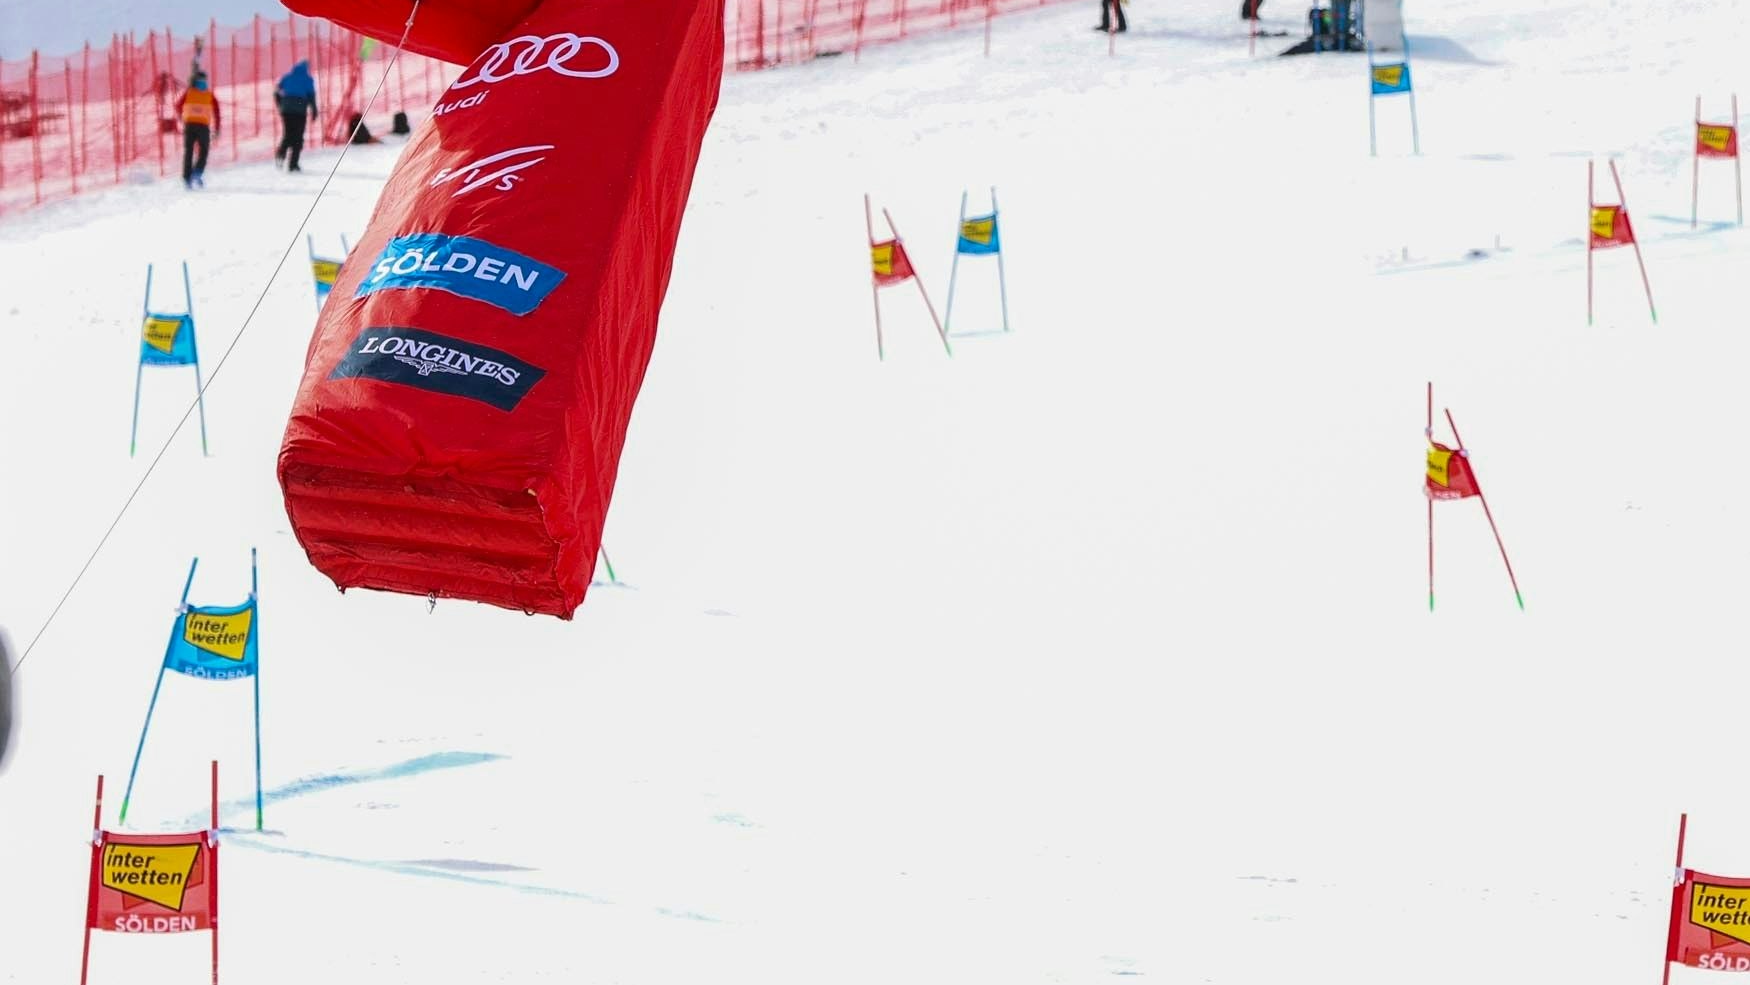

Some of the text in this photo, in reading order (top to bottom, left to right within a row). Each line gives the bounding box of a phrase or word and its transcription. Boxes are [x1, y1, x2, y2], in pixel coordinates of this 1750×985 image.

[433, 90, 490, 116] Audi
[371, 248, 540, 292] SÖLDEN
[359, 337, 521, 386] LONGINES
[189, 614, 229, 633] inter
[192, 632, 246, 645] wetten
[107, 845, 155, 868] inter
[112, 870, 183, 885] wetten
[1697, 885, 1748, 909] inter
[115, 914, 196, 932] SÖLDEN
